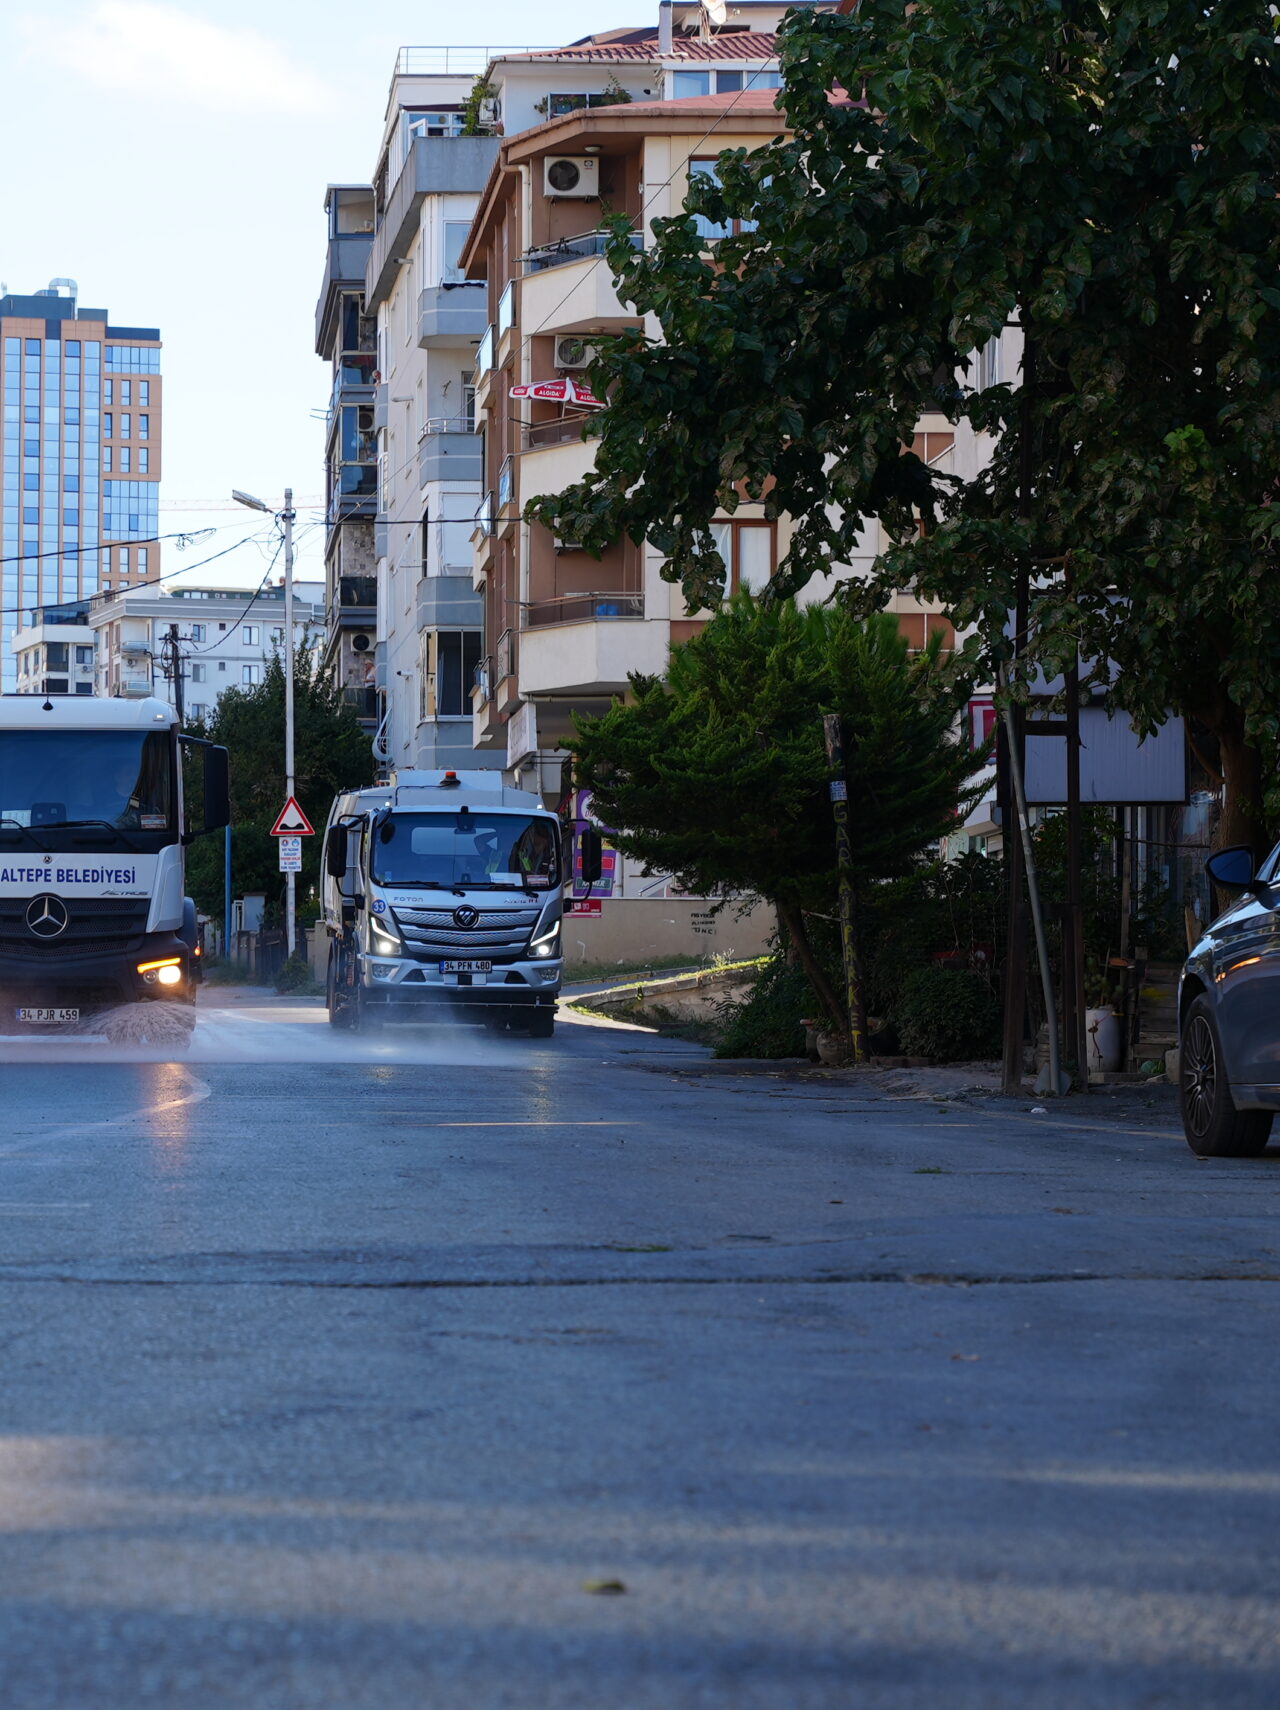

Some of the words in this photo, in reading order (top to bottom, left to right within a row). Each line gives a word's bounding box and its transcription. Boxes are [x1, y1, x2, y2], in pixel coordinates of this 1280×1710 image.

[538, 389, 561, 397] ALGIDA
[56, 865, 136, 884] BELEDİYESİ
[373, 901, 385, 912] 33
[444, 962, 454, 970] 34
[457, 962, 472, 970] PFN
[475, 962, 490, 970] 480
[21, 1009, 32, 1020] 34
[37, 1009, 55, 1020] PJR
[60, 1009, 78, 1020] 459
